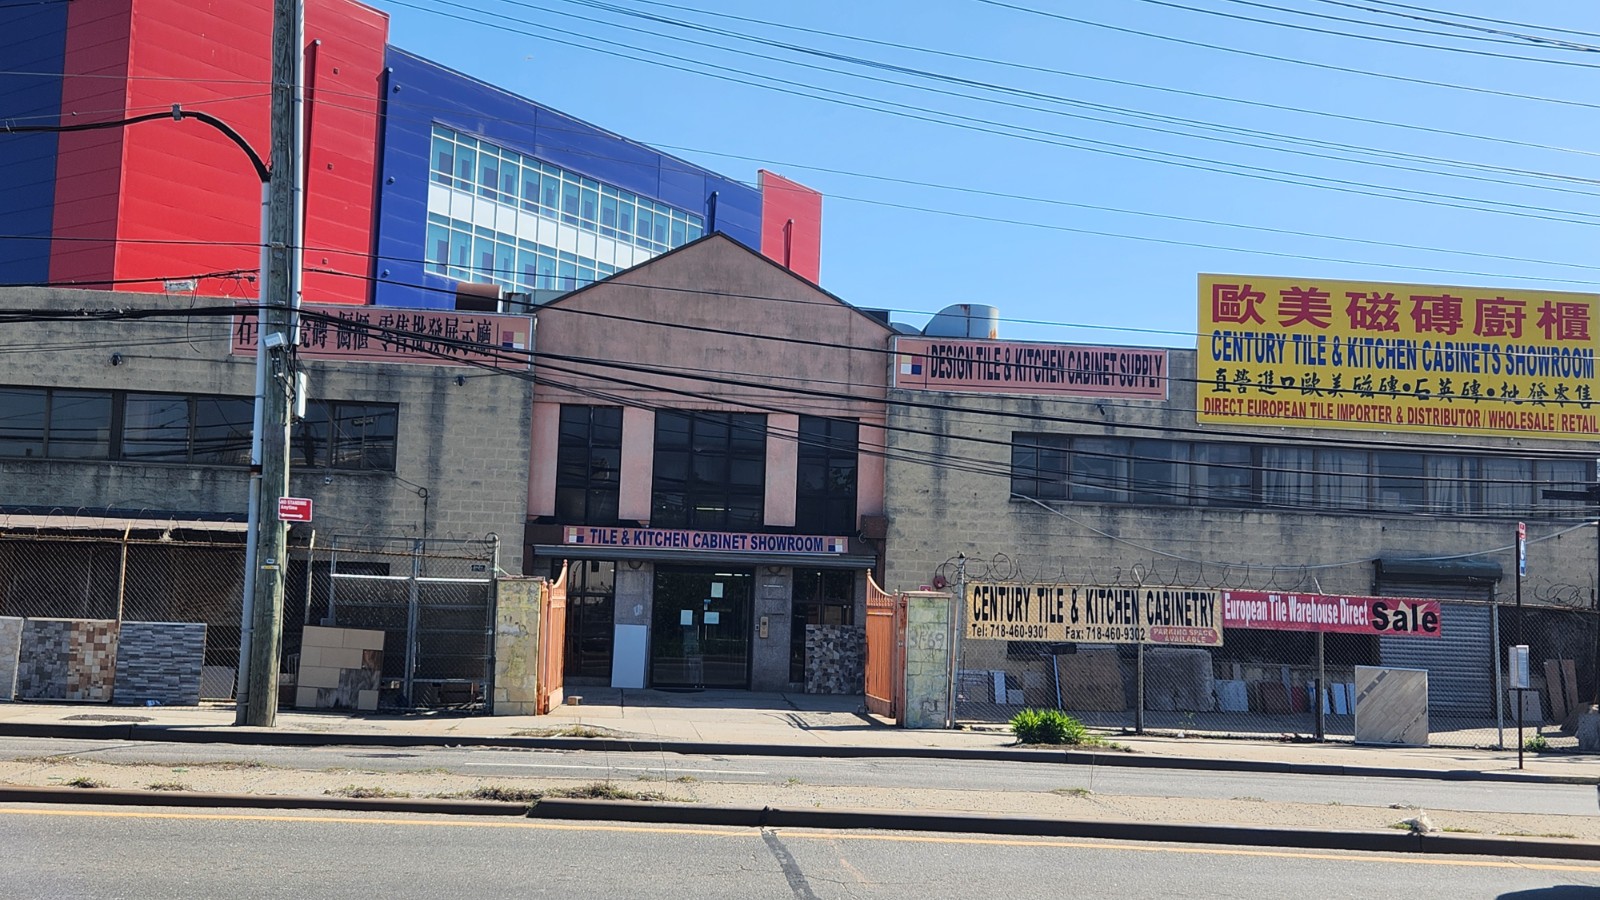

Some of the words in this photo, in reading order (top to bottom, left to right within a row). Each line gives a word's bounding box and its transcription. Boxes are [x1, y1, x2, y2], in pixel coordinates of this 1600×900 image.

[1211, 284, 1591, 341] 歐美磁磚廚櫃
[931, 344, 974, 380] DESIGN
[976, 347, 1001, 381] TILE
[1004, 347, 1012, 381] &
[1015, 348, 1065, 384] KITCHEN
[1067, 350, 1118, 387] CABINET
[1120, 352, 1163, 388] SUPPLY
[1211, 330, 1287, 364] CENTURY
[1292, 334, 1327, 366] TILE
[1331, 335, 1343, 367] &
[1347, 337, 1417, 370] KITCHEN
[1422, 340, 1502, 375] CABINETS
[1505, 344, 1595, 379] SHOWROOM
[1204, 397, 1244, 418] DIRECT
[1247, 398, 1307, 419] EUROPEAN
[1310, 401, 1334, 420] TILE
[1337, 403, 1392, 423] IMPORTER
[1396, 405, 1403, 423] &
[1407, 406, 1481, 427] DISTRIBUTOR
[1489, 410, 1555, 431] WHOLESALE
[1561, 413, 1599, 433] RETAIL
[590, 528, 618, 545] TILE
[621, 529, 630, 545] &
[633, 530, 689, 548] KITCHEN
[692, 531, 748, 550] CABINET
[750, 534, 824, 552] SHOWROOM
[973, 586, 1031, 622] CENTURY
[1037, 587, 1064, 623] TILE
[1070, 588, 1079, 624] &
[1085, 588, 1140, 625] KITCHEN
[1146, 590, 1216, 627] CABINETRY
[1224, 592, 1268, 627] European
[1268, 594, 1287, 622] Tile
[1288, 596, 1339, 625] Warehouse
[1340, 598, 1369, 626] Direct
[1371, 601, 1438, 633] Sale
[971, 624, 988, 638] Tel:
[990, 625, 1049, 639] 718-460-9301
[1065, 626, 1084, 640] Fax:
[1086, 627, 1146, 641] 718-460-9302
[1153, 628, 1188, 636] PARKING
[1188, 629, 1213, 637] SPACE
